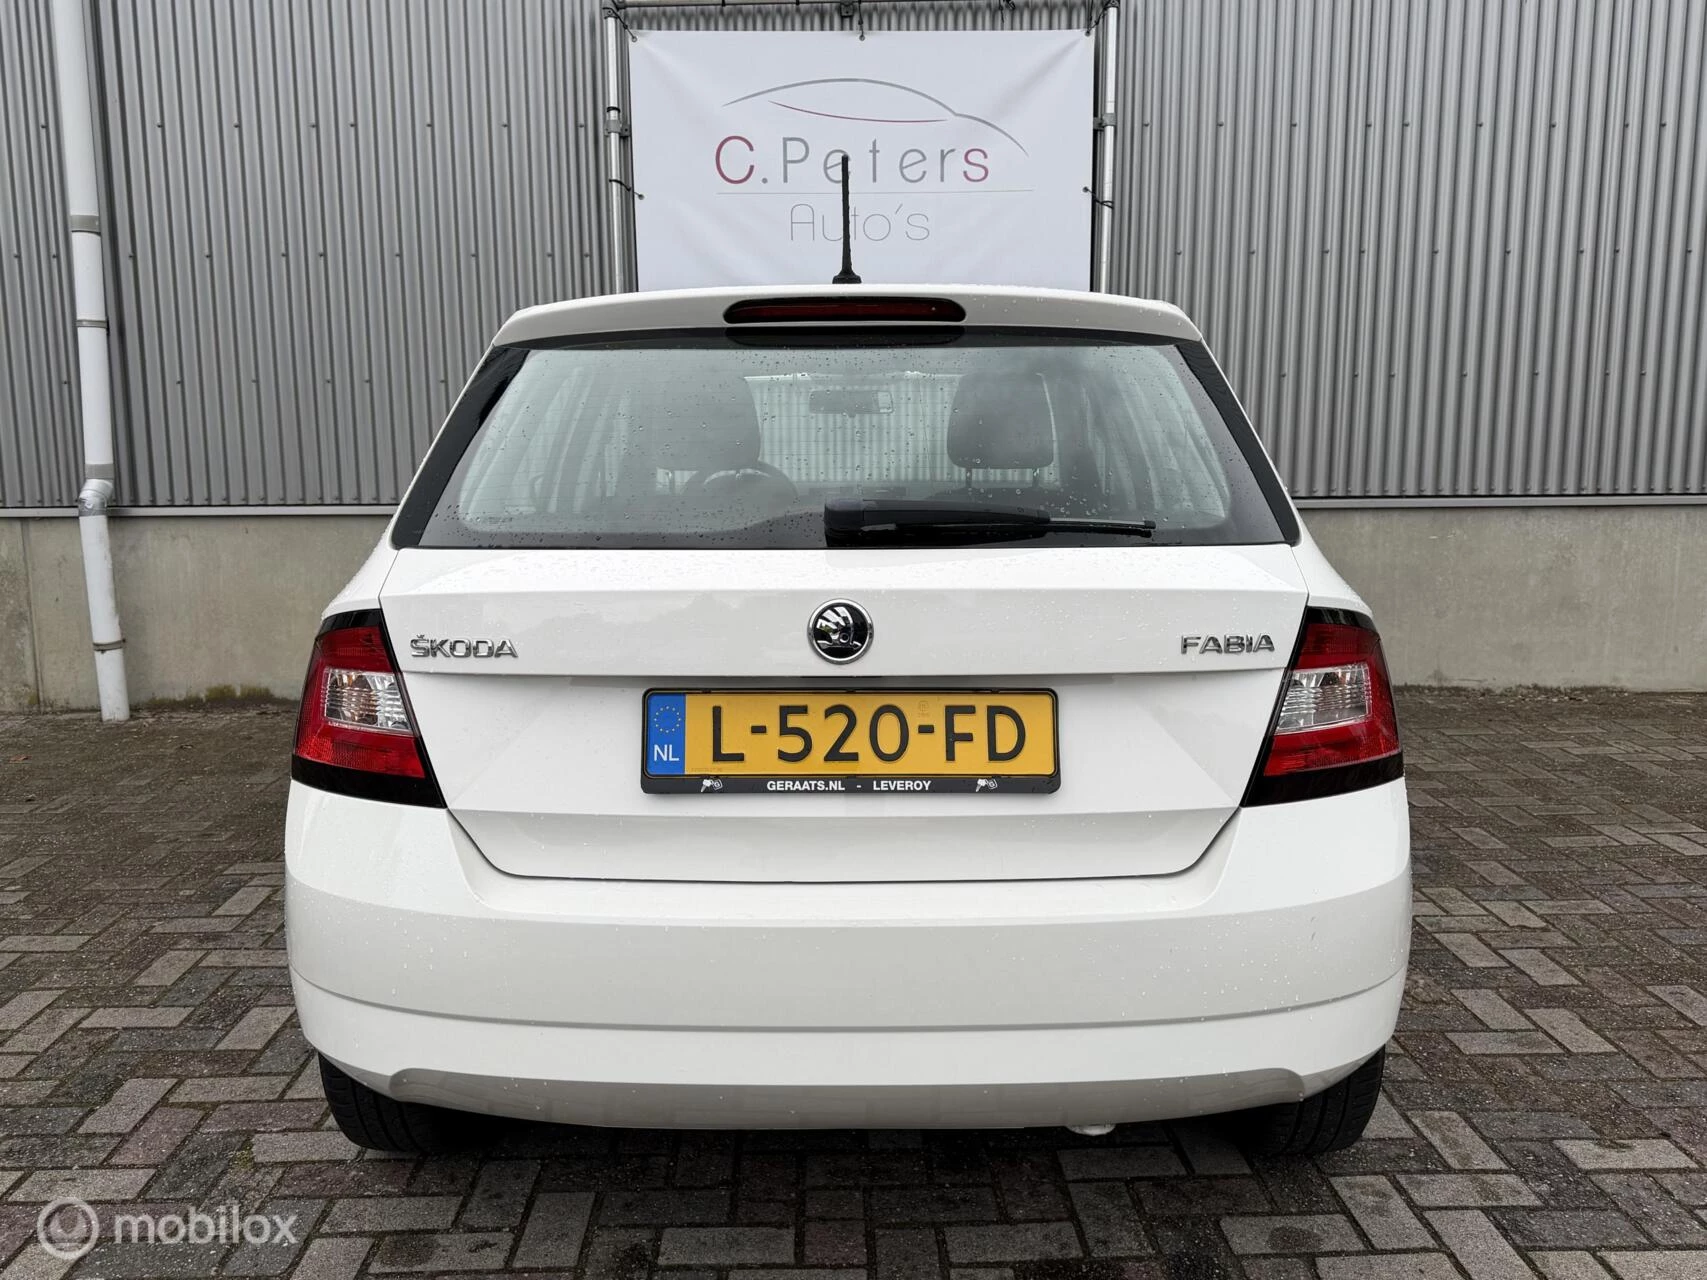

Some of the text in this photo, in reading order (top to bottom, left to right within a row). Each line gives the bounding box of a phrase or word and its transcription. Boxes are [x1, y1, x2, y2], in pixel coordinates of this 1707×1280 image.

[410, 634, 519, 658] ŠKODA
[1181, 634, 1275, 655] FABIA
[653, 704, 1027, 763] NL L-520-FD
[766, 780, 846, 791] GERAATS.NL
[873, 780, 932, 791] LEVEROY
